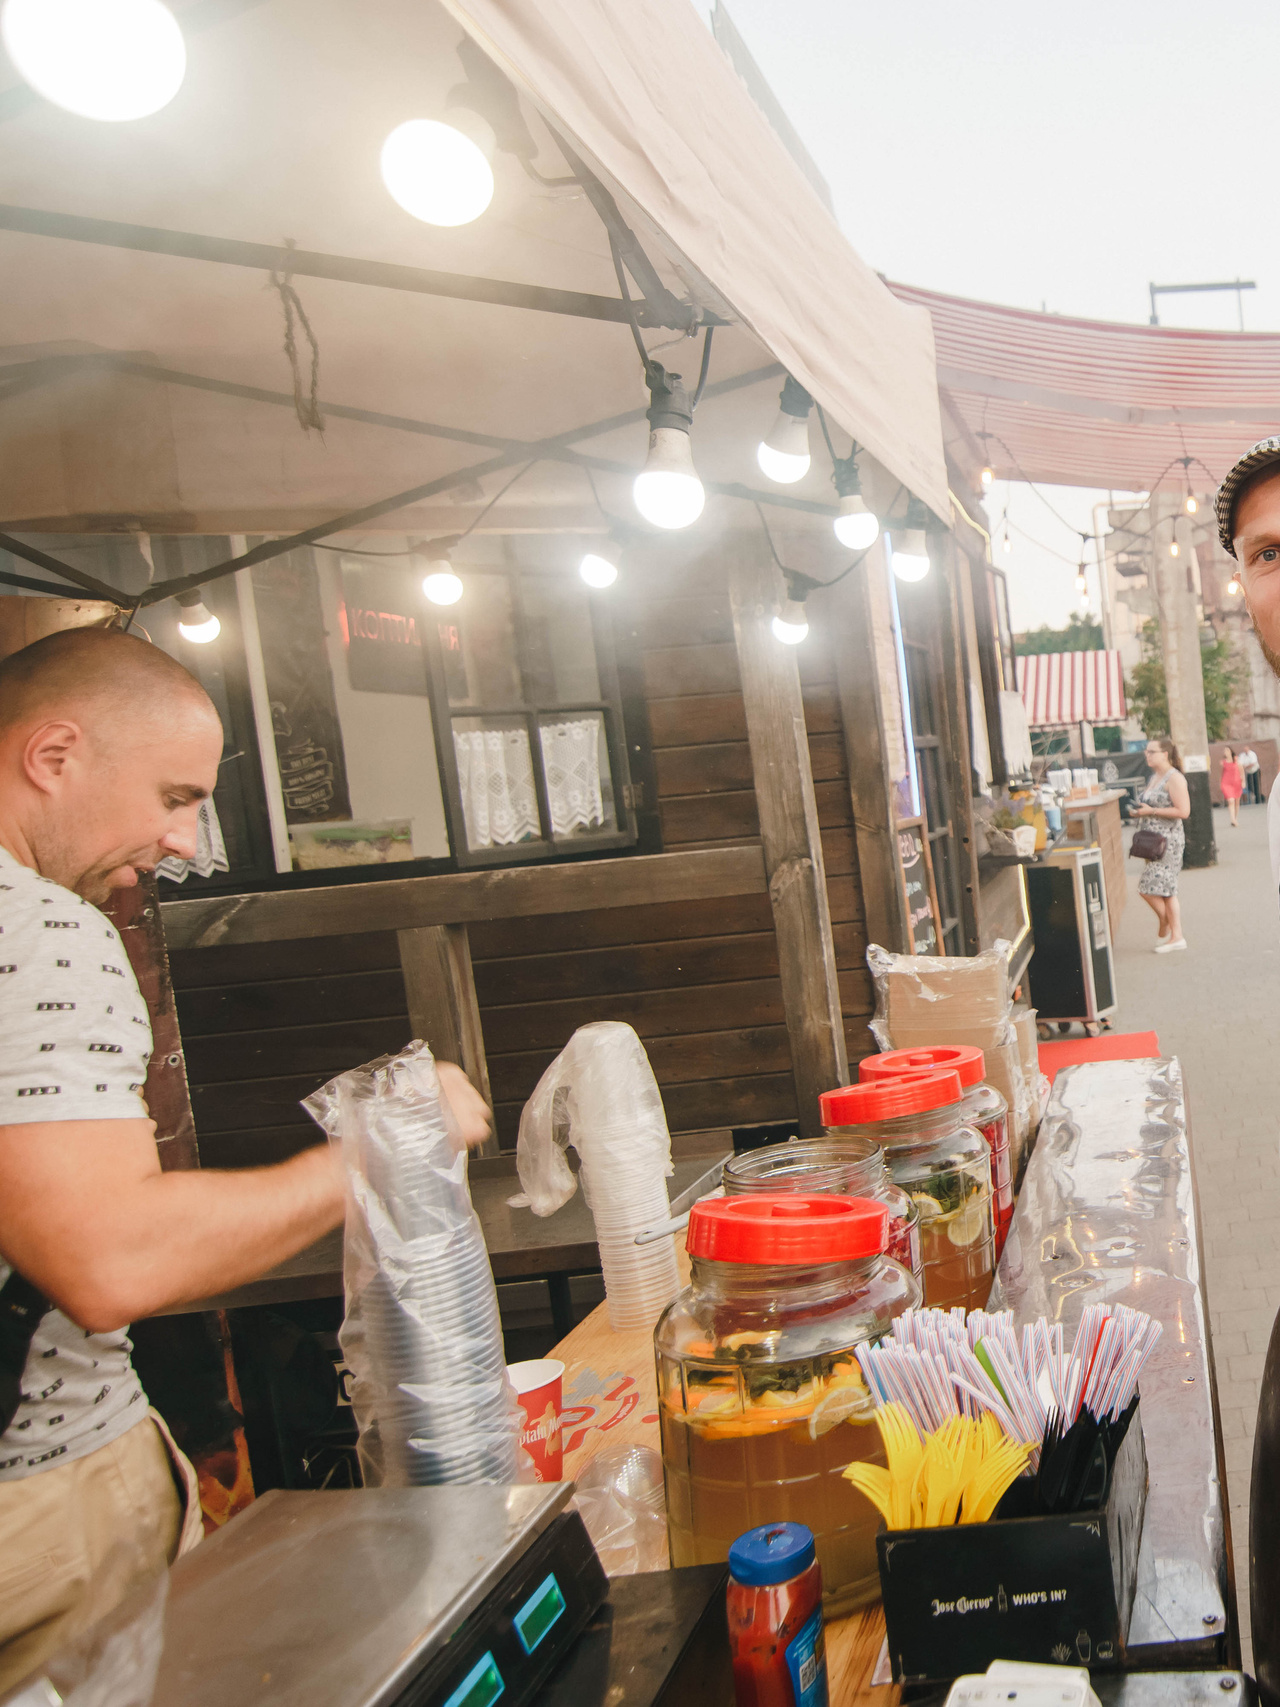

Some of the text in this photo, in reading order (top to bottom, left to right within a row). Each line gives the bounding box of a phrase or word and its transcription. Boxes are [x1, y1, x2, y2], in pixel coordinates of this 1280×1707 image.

[931, 1599, 956, 1617] Jose
[1012, 1591, 1048, 1607] WHO'S
[1050, 1588, 1067, 1602] IN?
